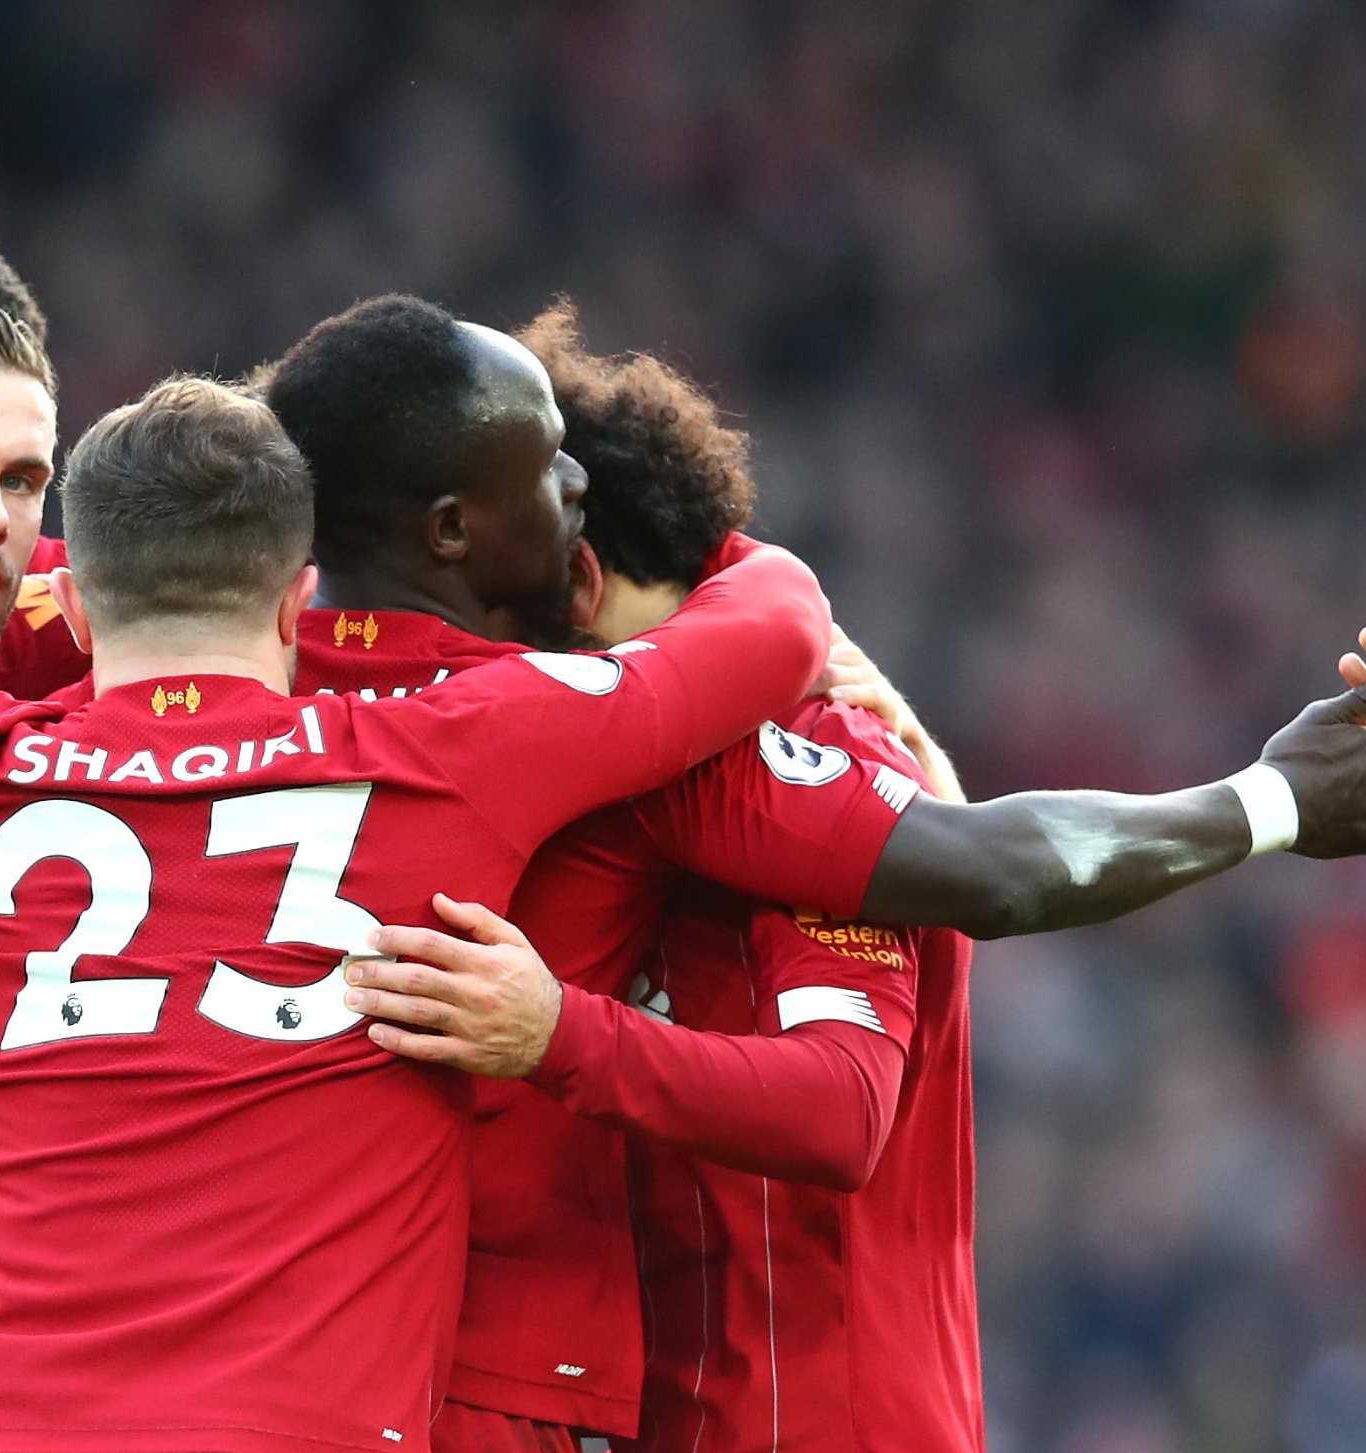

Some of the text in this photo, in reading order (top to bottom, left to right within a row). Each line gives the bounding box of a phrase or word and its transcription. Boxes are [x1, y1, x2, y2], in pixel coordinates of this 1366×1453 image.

[347, 621, 363, 636] 96
[167, 690, 185, 706] 96
[6, 705, 326, 785] SHAQIRI
